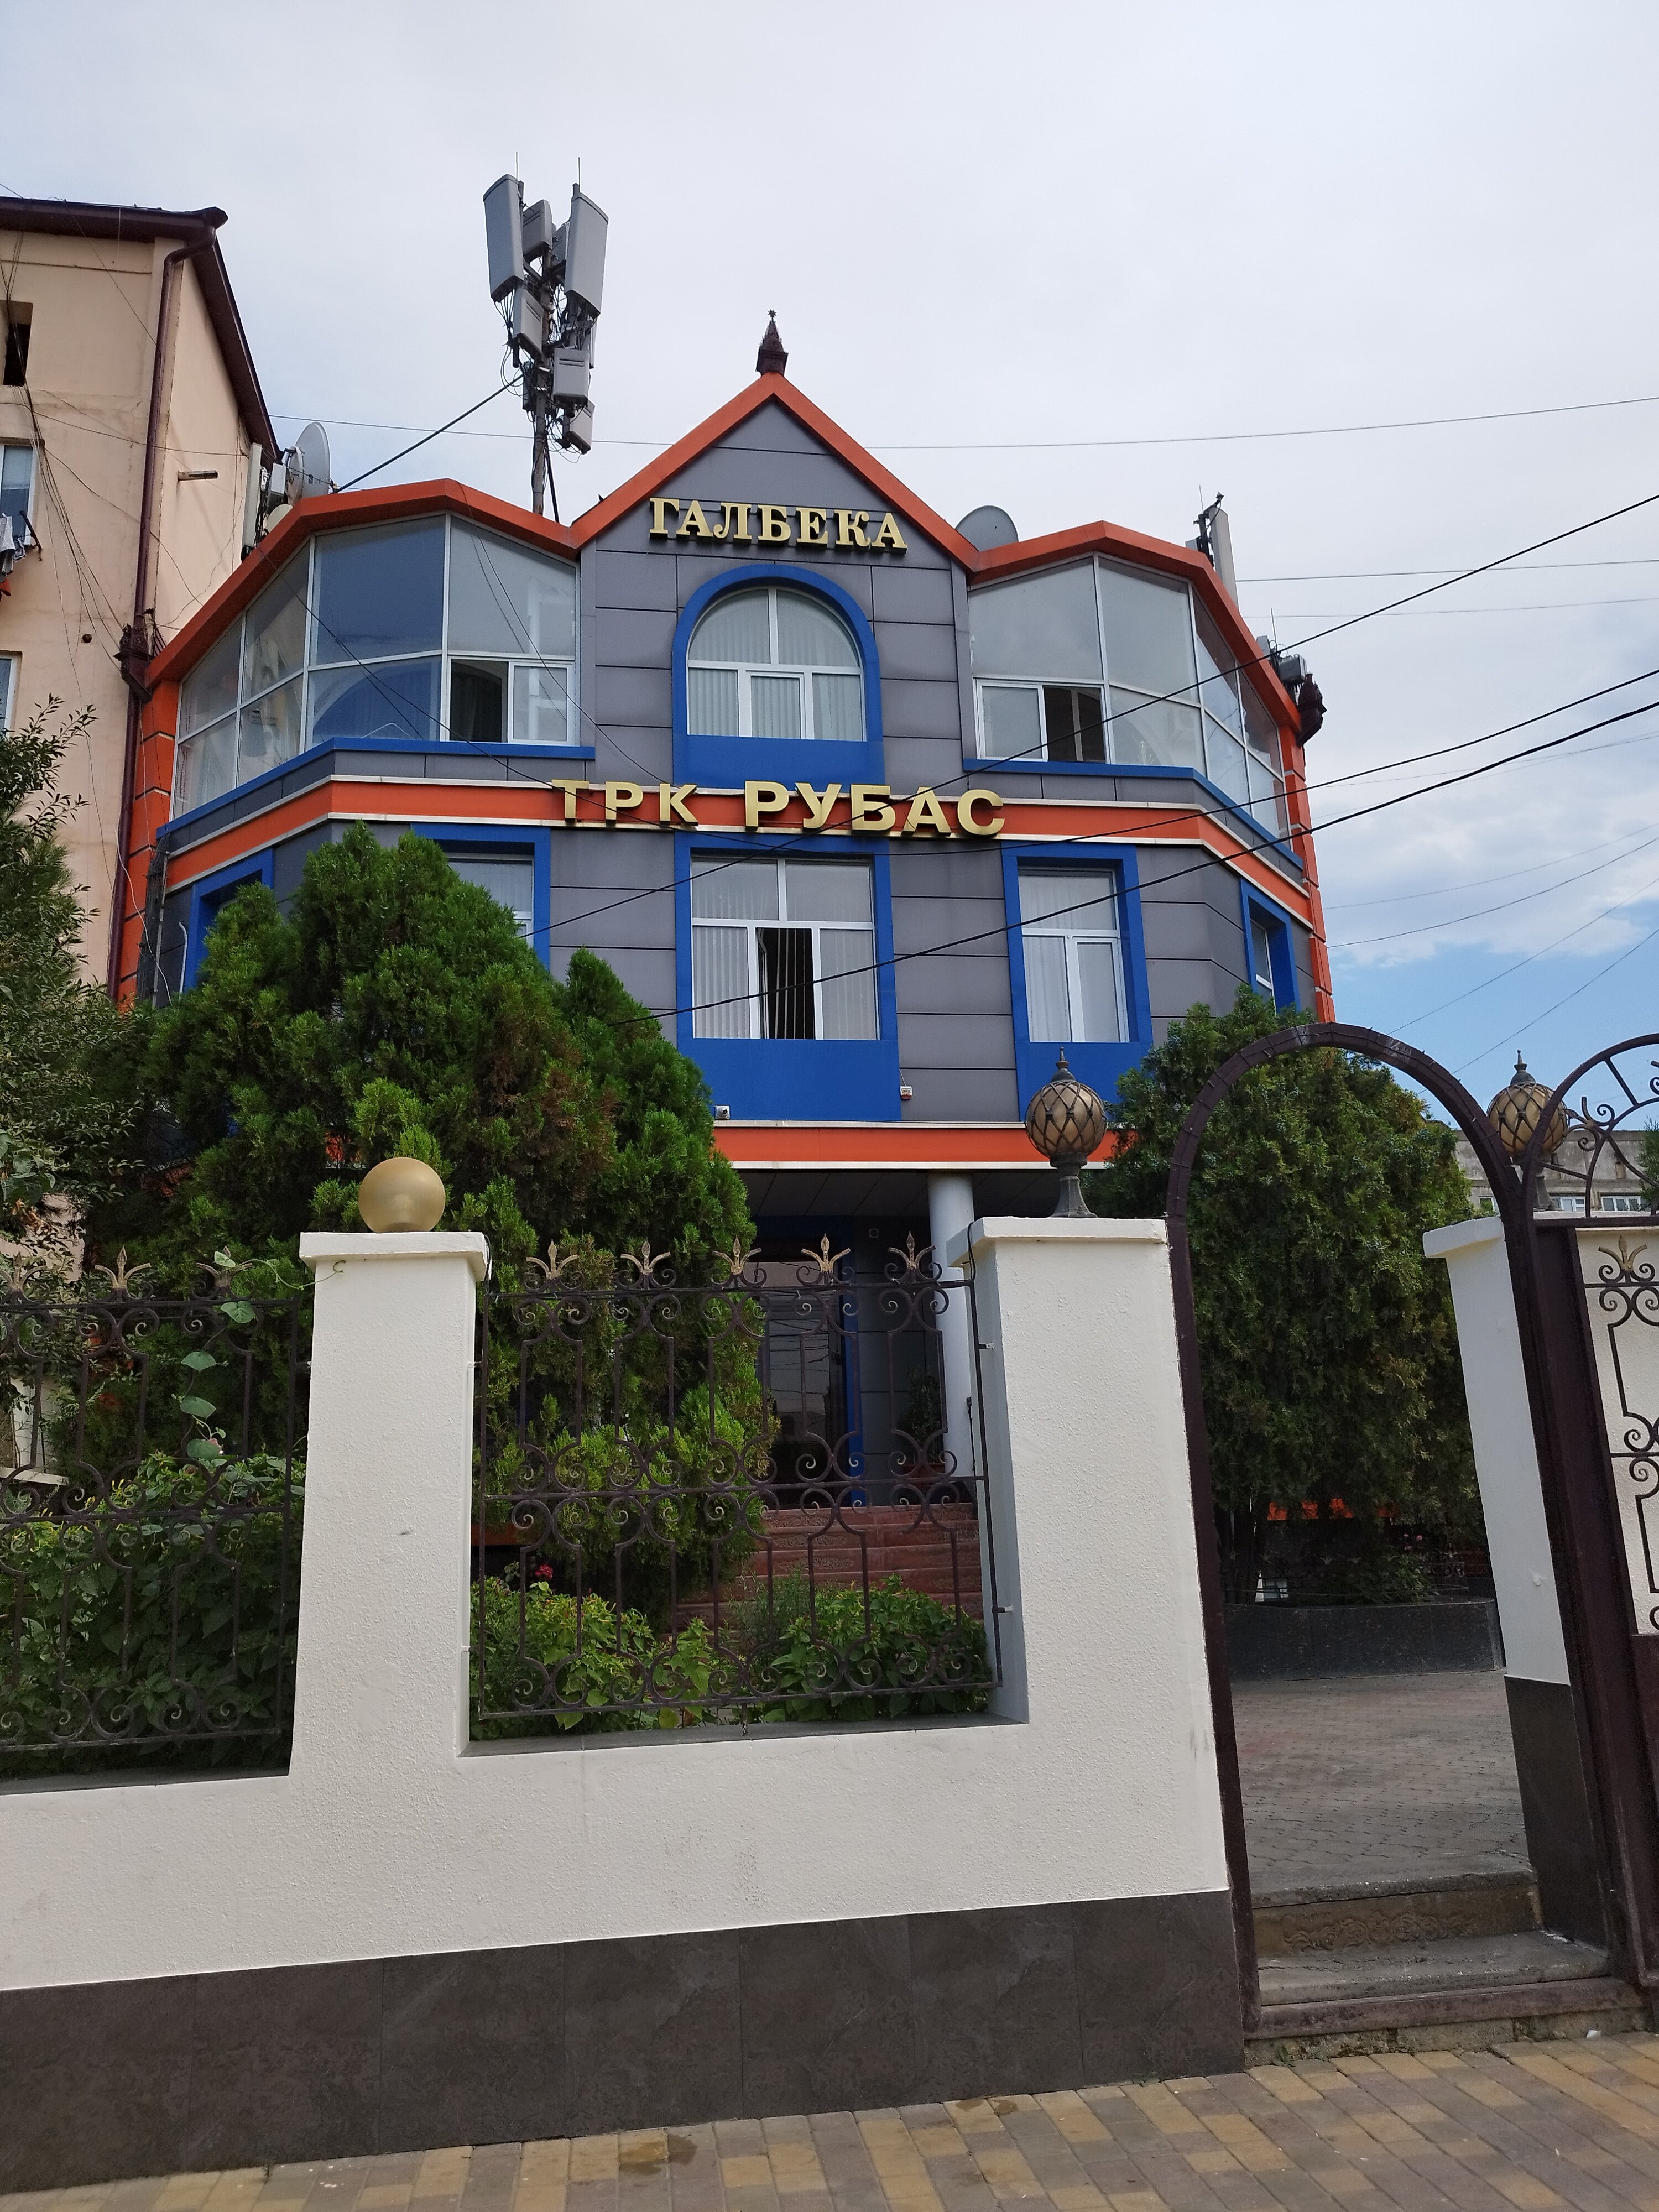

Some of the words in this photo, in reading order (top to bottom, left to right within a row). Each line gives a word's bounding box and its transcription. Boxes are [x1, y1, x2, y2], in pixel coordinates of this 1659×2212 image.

[649, 498, 907, 551] ГАЛБЕКА
[551, 779, 699, 826] ТРК
[744, 780, 1005, 837] РУБАС
